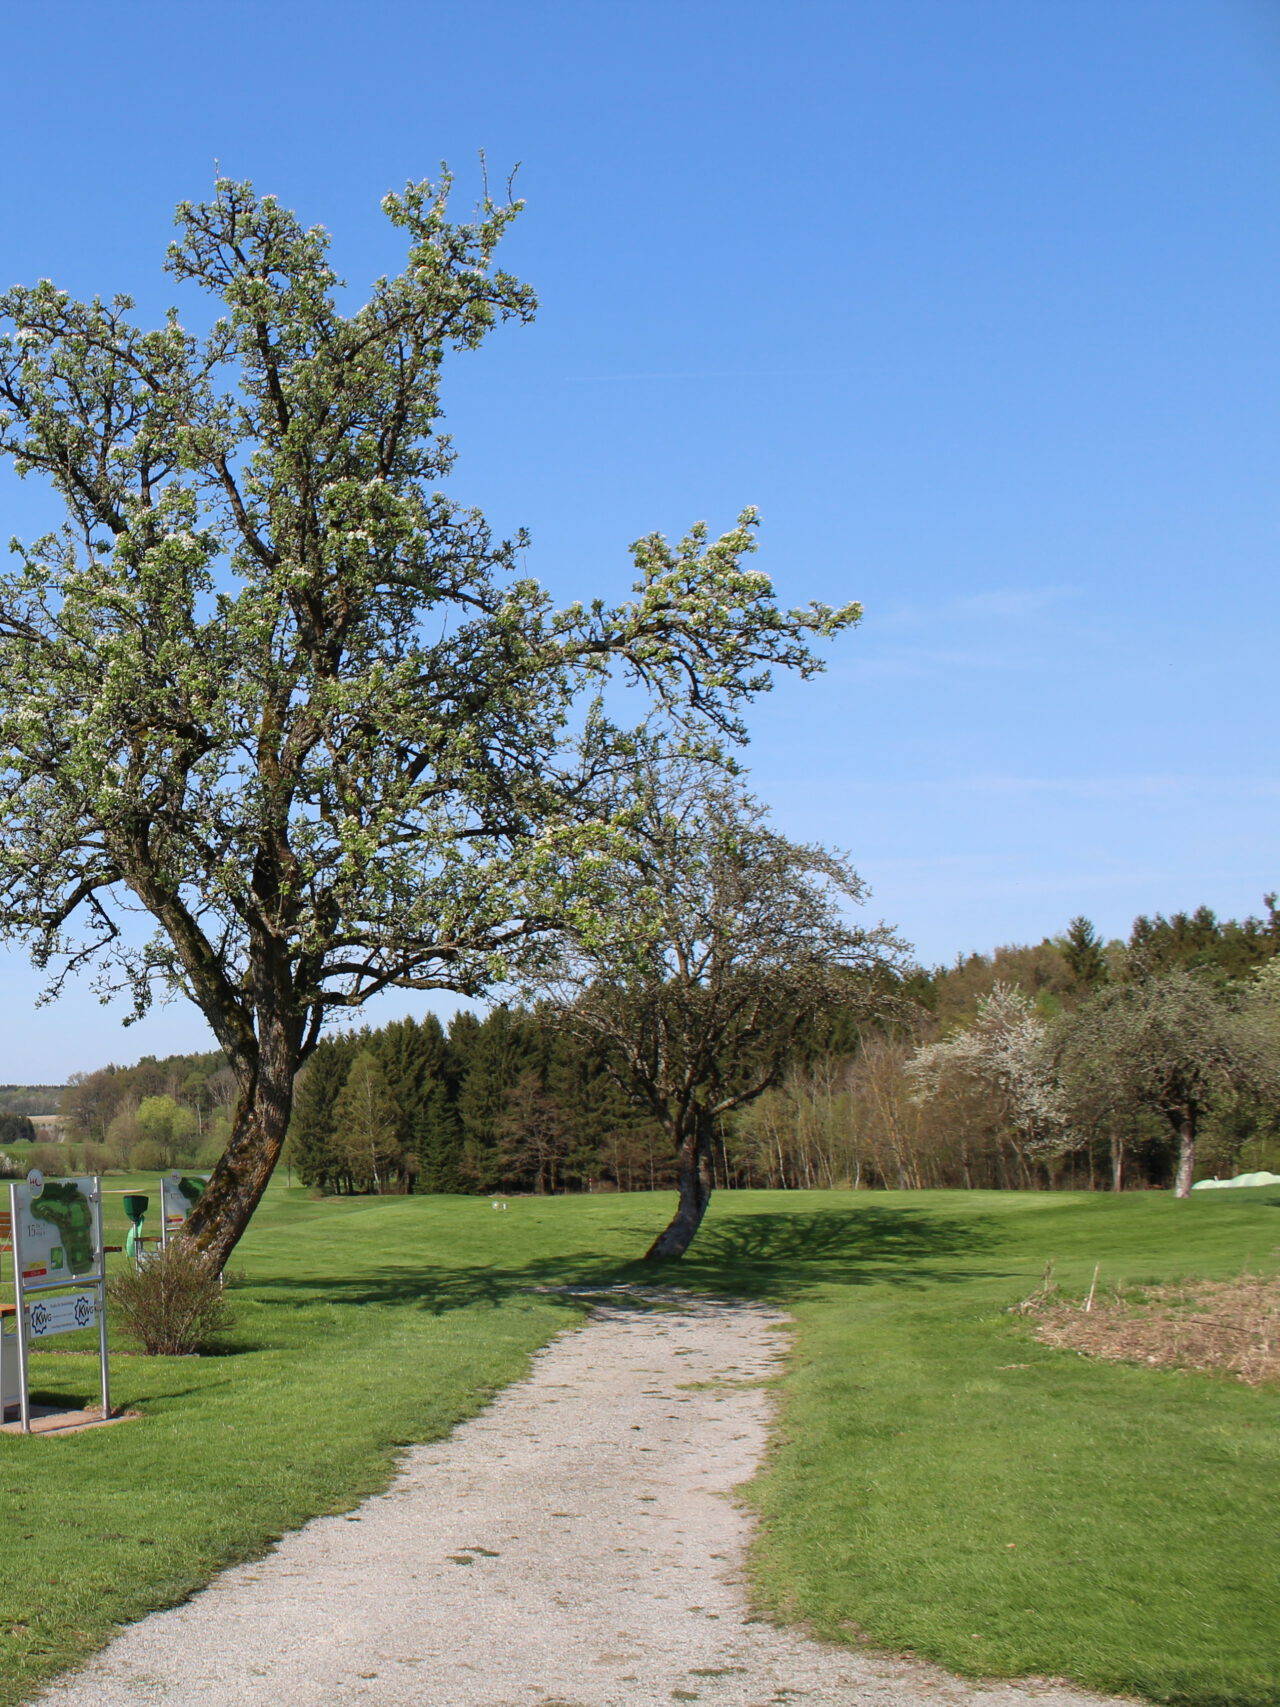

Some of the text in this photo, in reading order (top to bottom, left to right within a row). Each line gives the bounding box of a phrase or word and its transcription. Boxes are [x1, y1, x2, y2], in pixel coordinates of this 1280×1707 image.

[27, 1224, 36, 1238] 15
[78, 1304, 94, 1319] KWG
[35, 1312, 52, 1326] KWG
